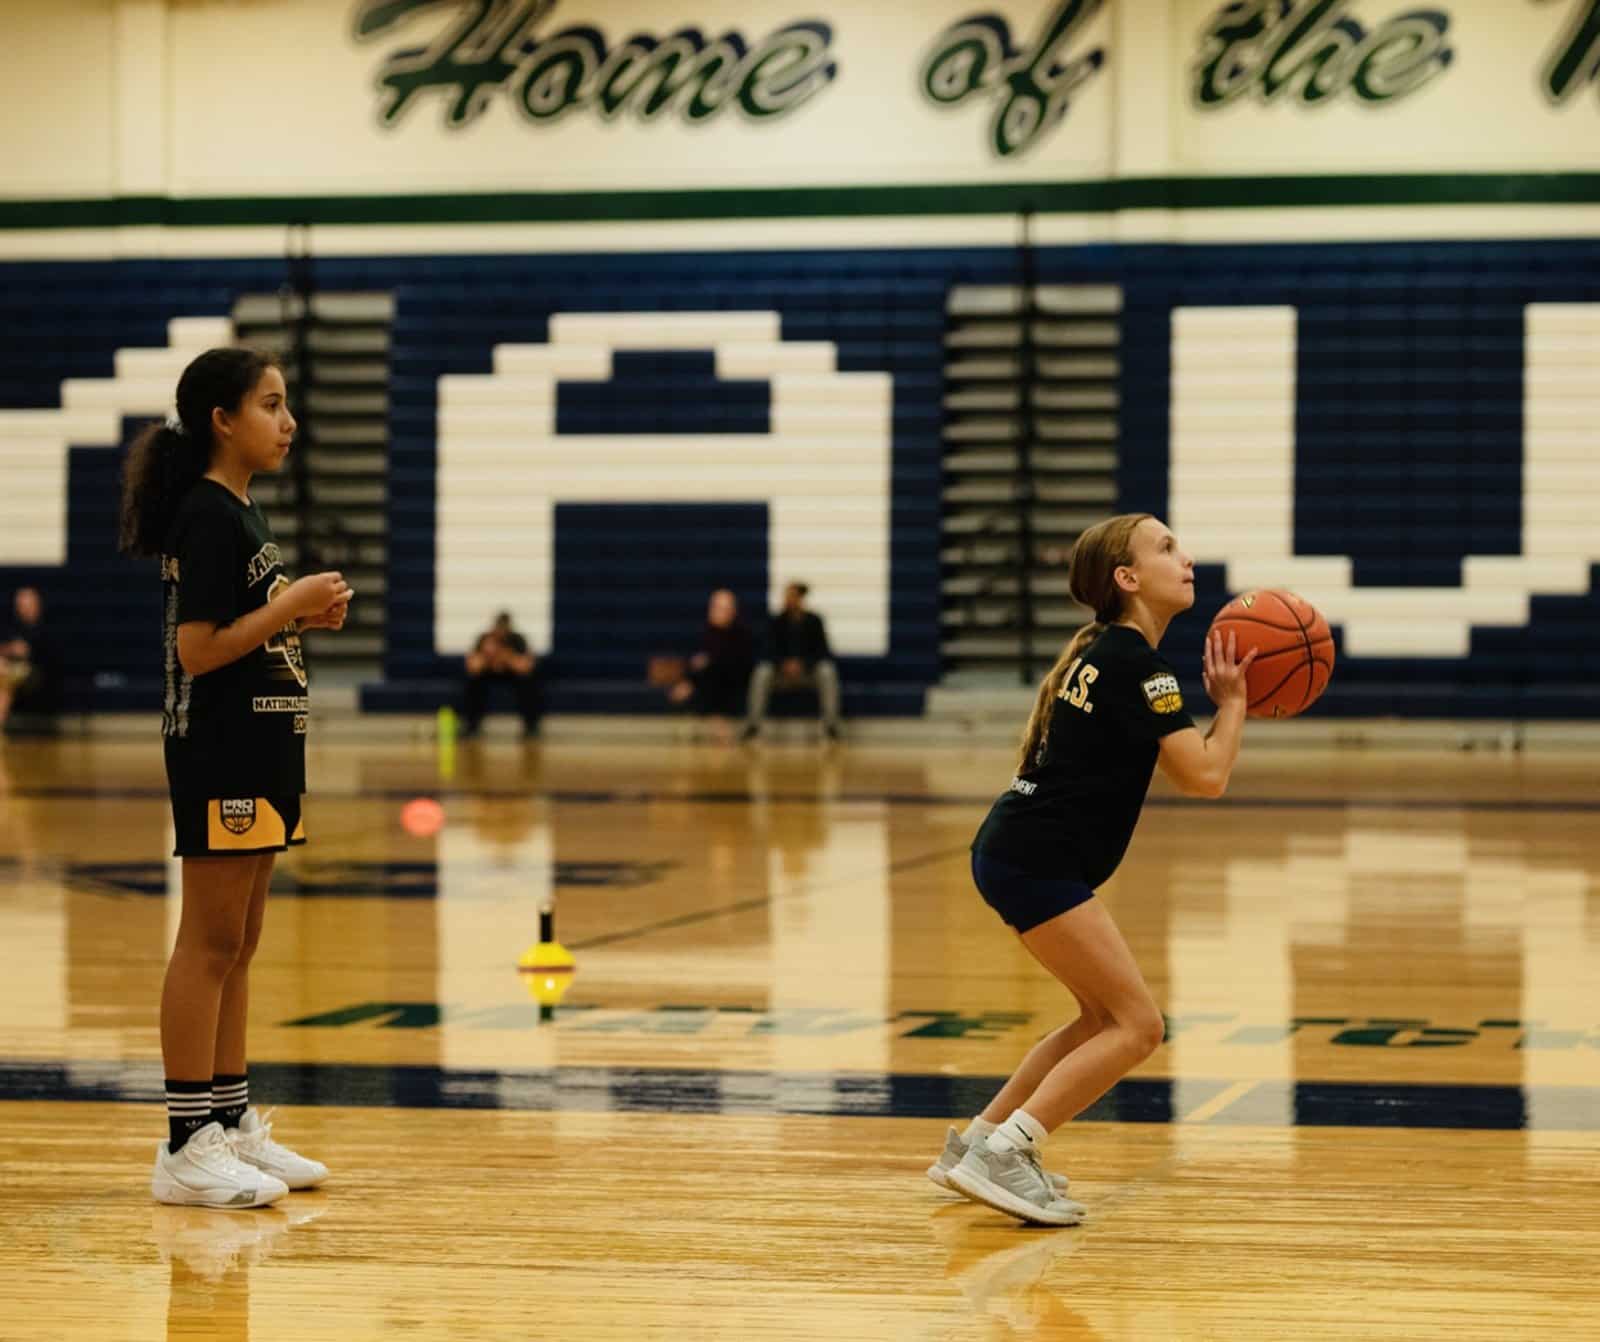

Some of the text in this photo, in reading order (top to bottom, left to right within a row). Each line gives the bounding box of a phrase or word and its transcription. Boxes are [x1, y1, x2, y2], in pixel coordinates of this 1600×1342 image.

[352, 0, 838, 127] Home
[919, 0, 1107, 157] of
[1192, 0, 1454, 108] the
